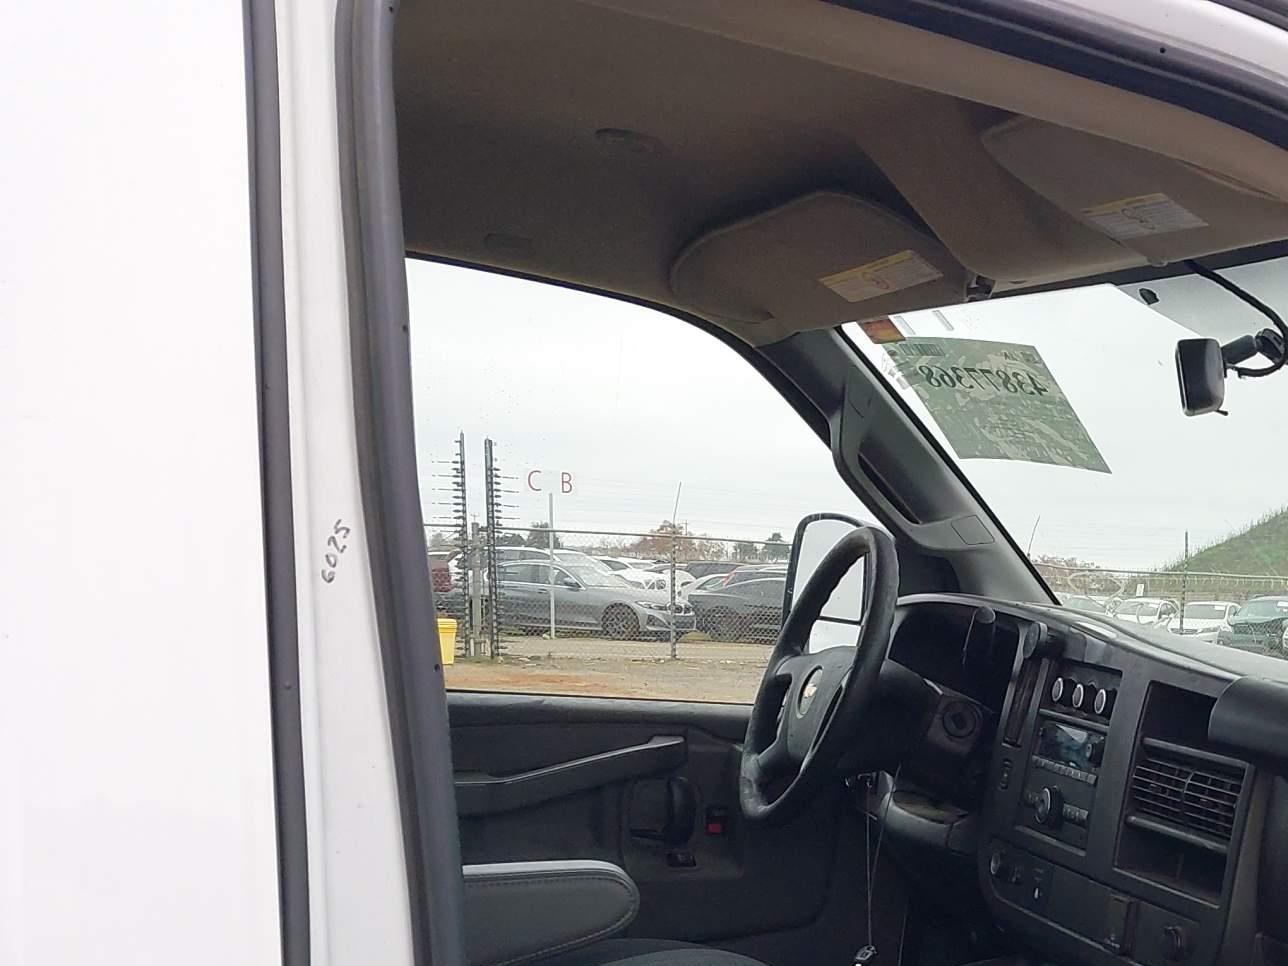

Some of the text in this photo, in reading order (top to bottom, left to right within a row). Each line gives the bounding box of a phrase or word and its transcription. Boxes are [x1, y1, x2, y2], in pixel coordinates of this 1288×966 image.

[527, 469, 542, 492] C
[561, 471, 573, 494] B
[320, 518, 352, 584] 6025
